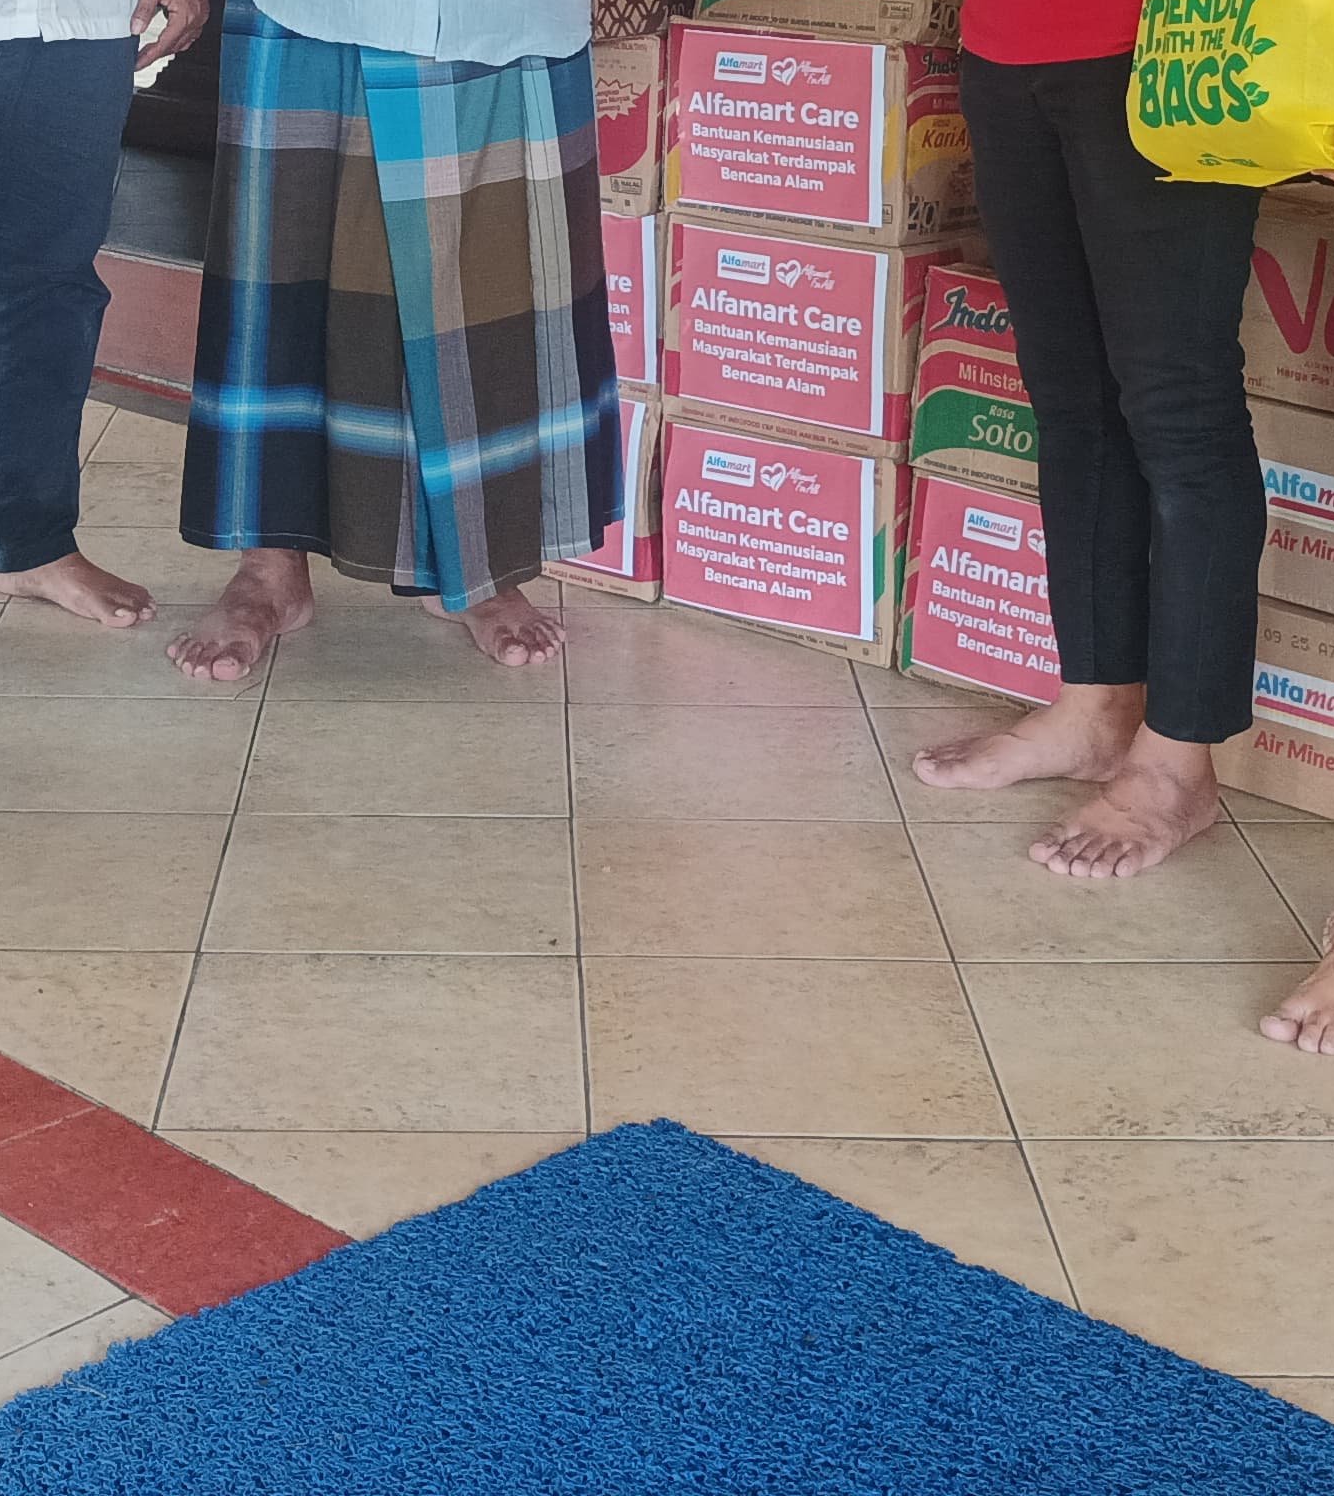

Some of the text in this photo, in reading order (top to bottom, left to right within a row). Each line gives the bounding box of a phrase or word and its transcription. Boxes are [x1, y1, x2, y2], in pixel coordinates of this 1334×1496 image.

[719, 57, 764, 70] Alfamart
[1139, 53, 1251, 128] BAGS
[688, 92, 859, 129] Alfamart Care
[692, 123, 854, 153] Bantuan Kemanusiaan
[691, 143, 856, 175] Masyarakat Terdampak
[721, 167, 824, 192] Bencana Alam
[721, 255, 766, 271] Alfamart
[691, 288, 862, 336] Alfamart Care
[929, 286, 1013, 334] Indo
[694, 319, 857, 360] Bantuan Kemanusiaan
[692, 339, 859, 382] Masyarakat Terdampak
[958, 362, 977, 383] Mi
[1276, 367, 1308, 383] Harga
[722, 365, 826, 397] Bencana Alam
[989, 404, 1015, 420] Rasa
[968, 414, 1033, 453] Soto
[706, 455, 751, 474] Alfamart
[675, 488, 849, 541] Alfamart Care
[968, 514, 1017, 535] Alfamart
[678, 520, 845, 565] Bantuan Kemanusiaan
[1268, 529, 1299, 552] Air
[676, 540, 847, 587] Masyarakat Terdampak
[930, 546, 1049, 599] Alfamart
[705, 567, 812, 601] Bencana Alam
[932, 580, 995, 610] Bantuan
[928, 601, 1013, 639] Masyarakat
[957, 633, 1023, 665] Bencana
[1254, 730, 1284, 755] Air
